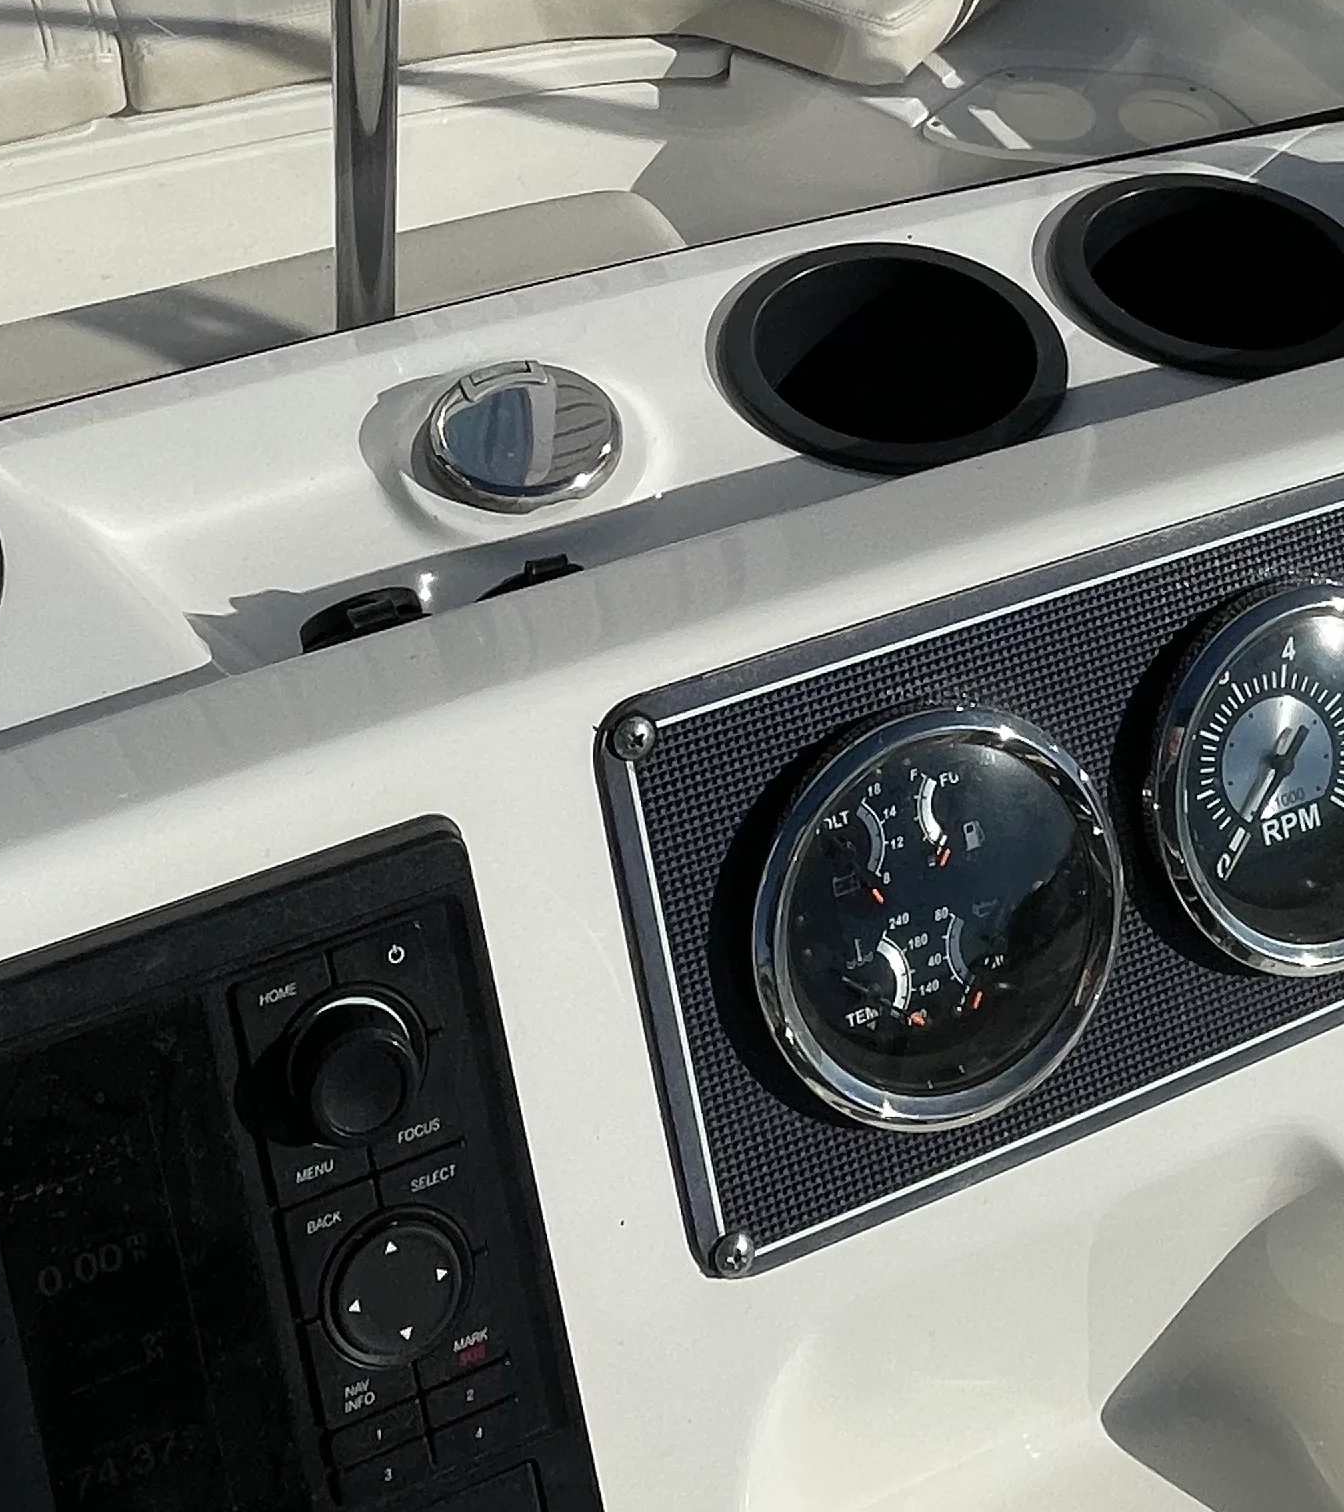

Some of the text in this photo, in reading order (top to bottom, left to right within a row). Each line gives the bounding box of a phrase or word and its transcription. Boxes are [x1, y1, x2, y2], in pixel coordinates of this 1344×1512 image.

[1281, 636, 1297, 661] 4
[910, 768, 920, 782] F
[883, 804, 898, 820] 14
[1260, 802, 1322, 847] RPM
[890, 836, 905, 851] 12
[888, 911, 911, 931] 240
[907, 932, 929, 951] 180
[927, 952, 943, 968] 40
[259, 982, 298, 1007] HOME
[919, 978, 941, 997] 140
[397, 1117, 442, 1145] FOCUS
[296, 1159, 336, 1185] MENU
[411, 1164, 457, 1194] SELECT
[306, 1210, 343, 1236] BACK
[453, 1326, 489, 1353] MARK
[344, 1378, 371, 1399] NAV
[466, 1388, 475, 1402] 2
[344, 1391, 376, 1414] INFO
[376, 1428, 383, 1442] 1
[474, 1426, 484, 1439] 4
[383, 1468, 393, 1483] 3
